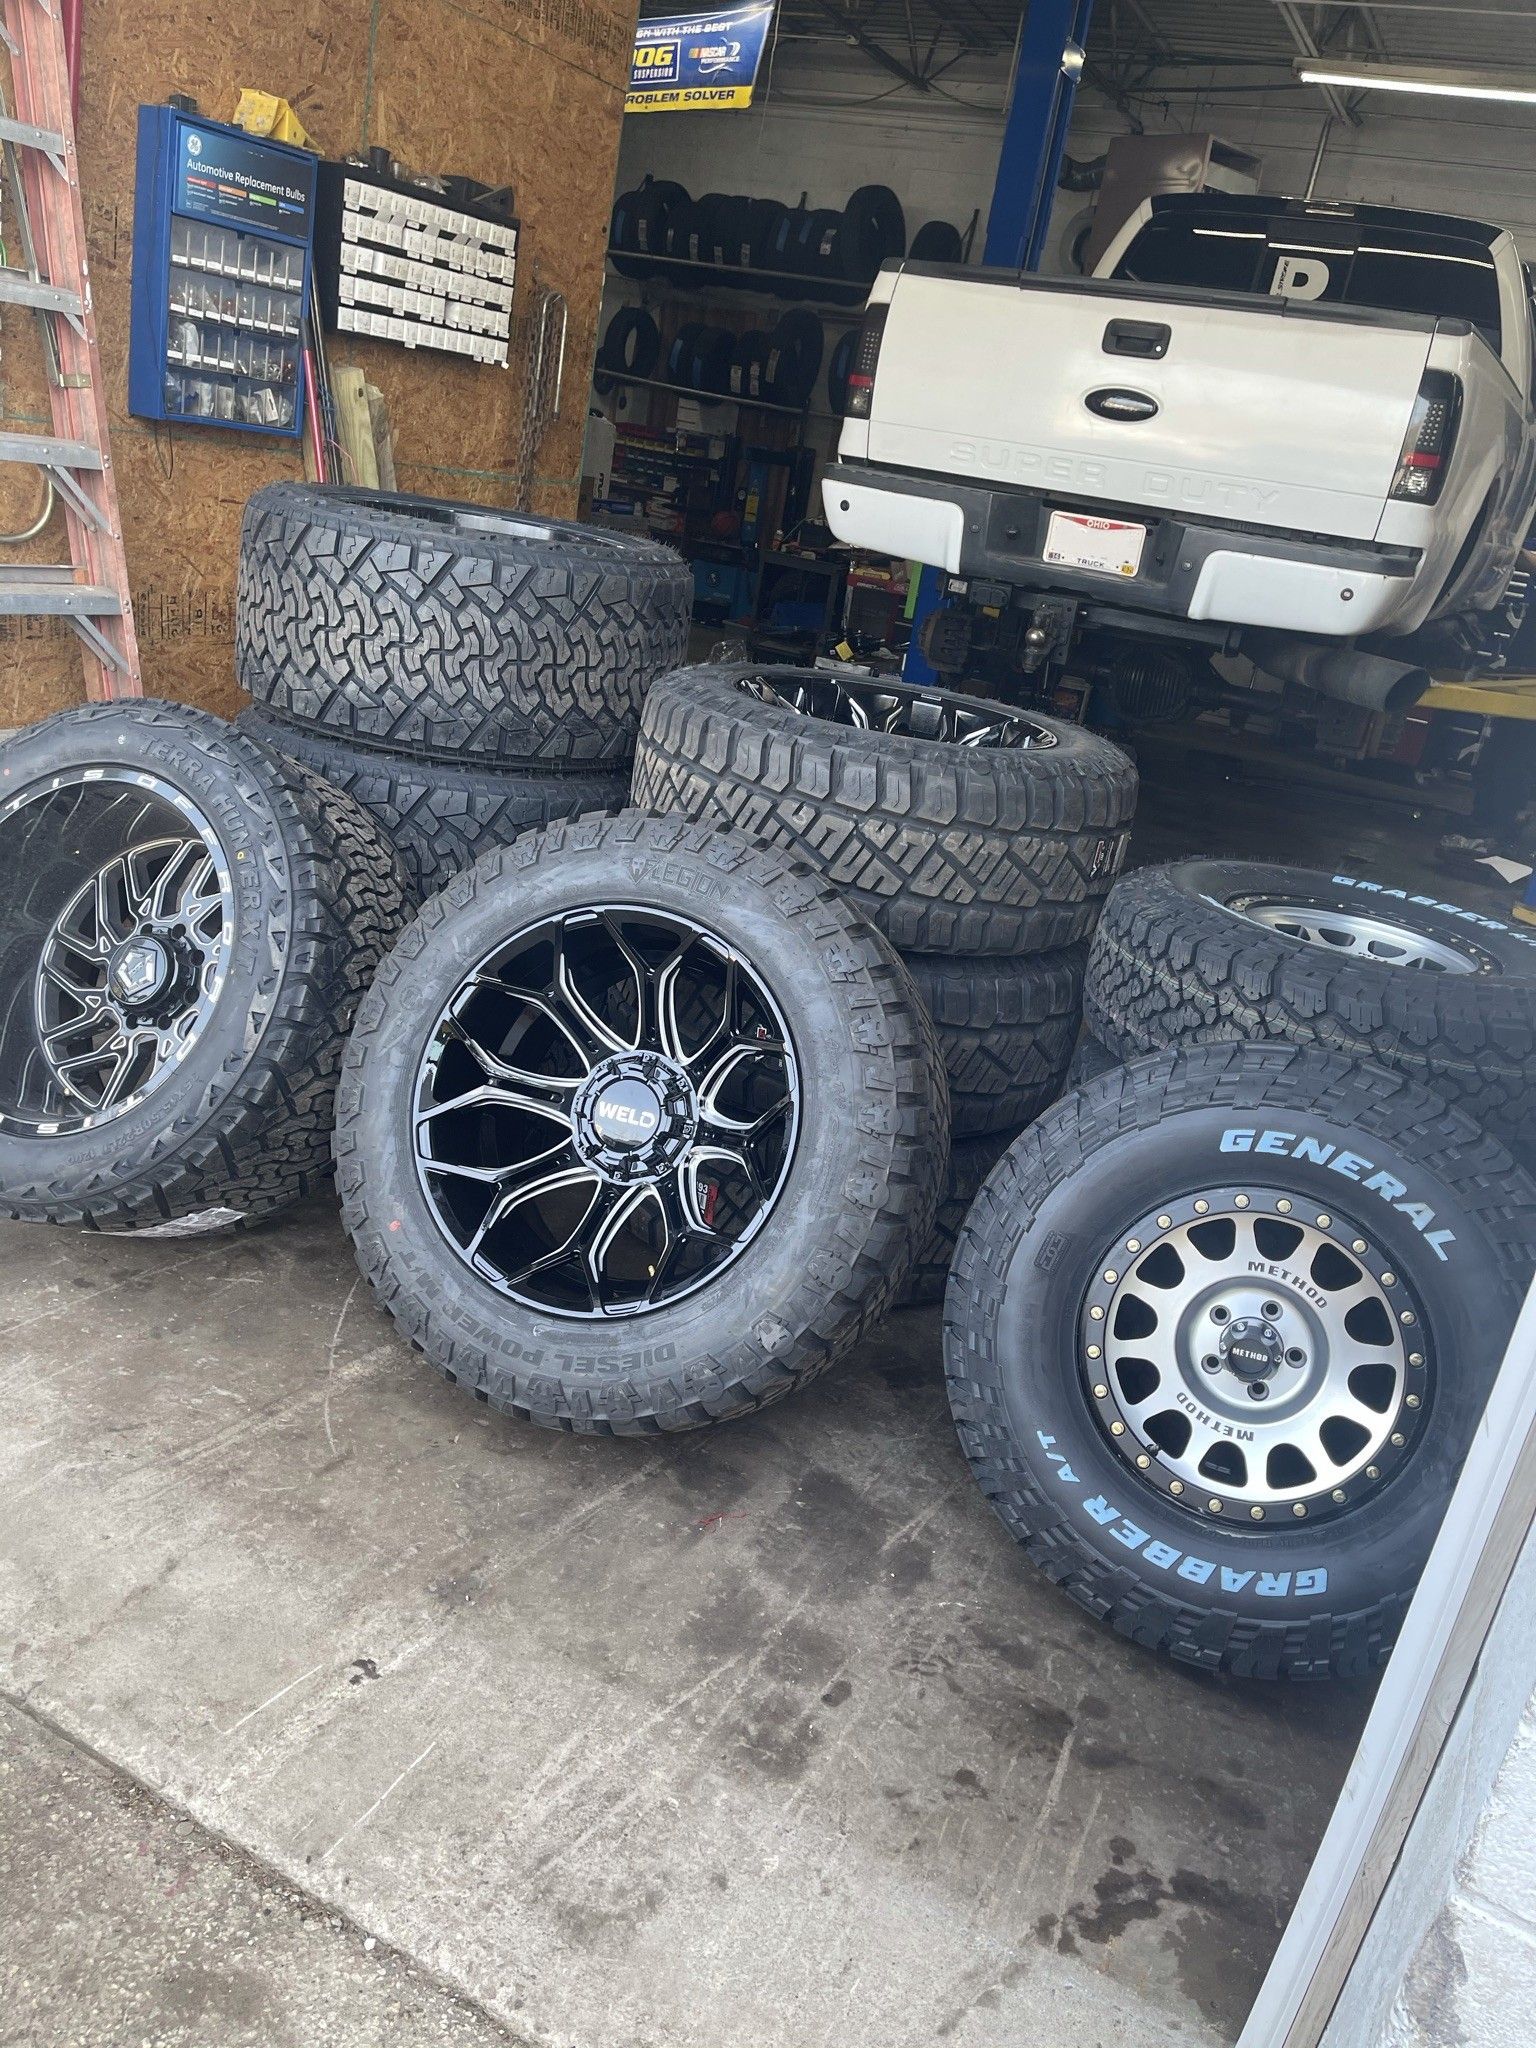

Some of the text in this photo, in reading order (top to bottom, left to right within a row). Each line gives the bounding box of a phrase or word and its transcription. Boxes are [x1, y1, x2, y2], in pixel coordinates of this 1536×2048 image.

[654, 27, 678, 37] WITH
[682, 25, 701, 34] THE
[703, 22, 733, 32] BEST
[632, 46, 675, 67] OG
[633, 67, 674, 80] SUSPENSION
[625, 90, 736, 105] ROBLEM SOLVER
[186, 158, 233, 181] Automotive
[235, 172, 285, 194] Replacement
[285, 187, 306, 202] Bulbs
[948, 441, 1280, 514] SUPER DUTY
[1086, 519, 1111, 530] OHIO
[1077, 557, 1106, 568] TRUCK
[142, 734, 217, 796] TERRA
[212, 792, 264, 912] HUNTER
[649, 859, 732, 901] LEGION
[1331, 874, 1509, 930] GRABBER
[599, 1100, 656, 1129] WELD
[697, 1181, 709, 1194] 93
[1218, 1128, 1457, 1262] GENERAL
[1247, 1260, 1328, 1309] METHOD
[442, 1303, 548, 1367] POWER
[554, 1341, 677, 1375] DIESEL
[1231, 1347, 1269, 1363] METHOD
[1176, 1391, 1255, 1442] METHOD
[1037, 1430, 1329, 1597] GRABBER A/T
